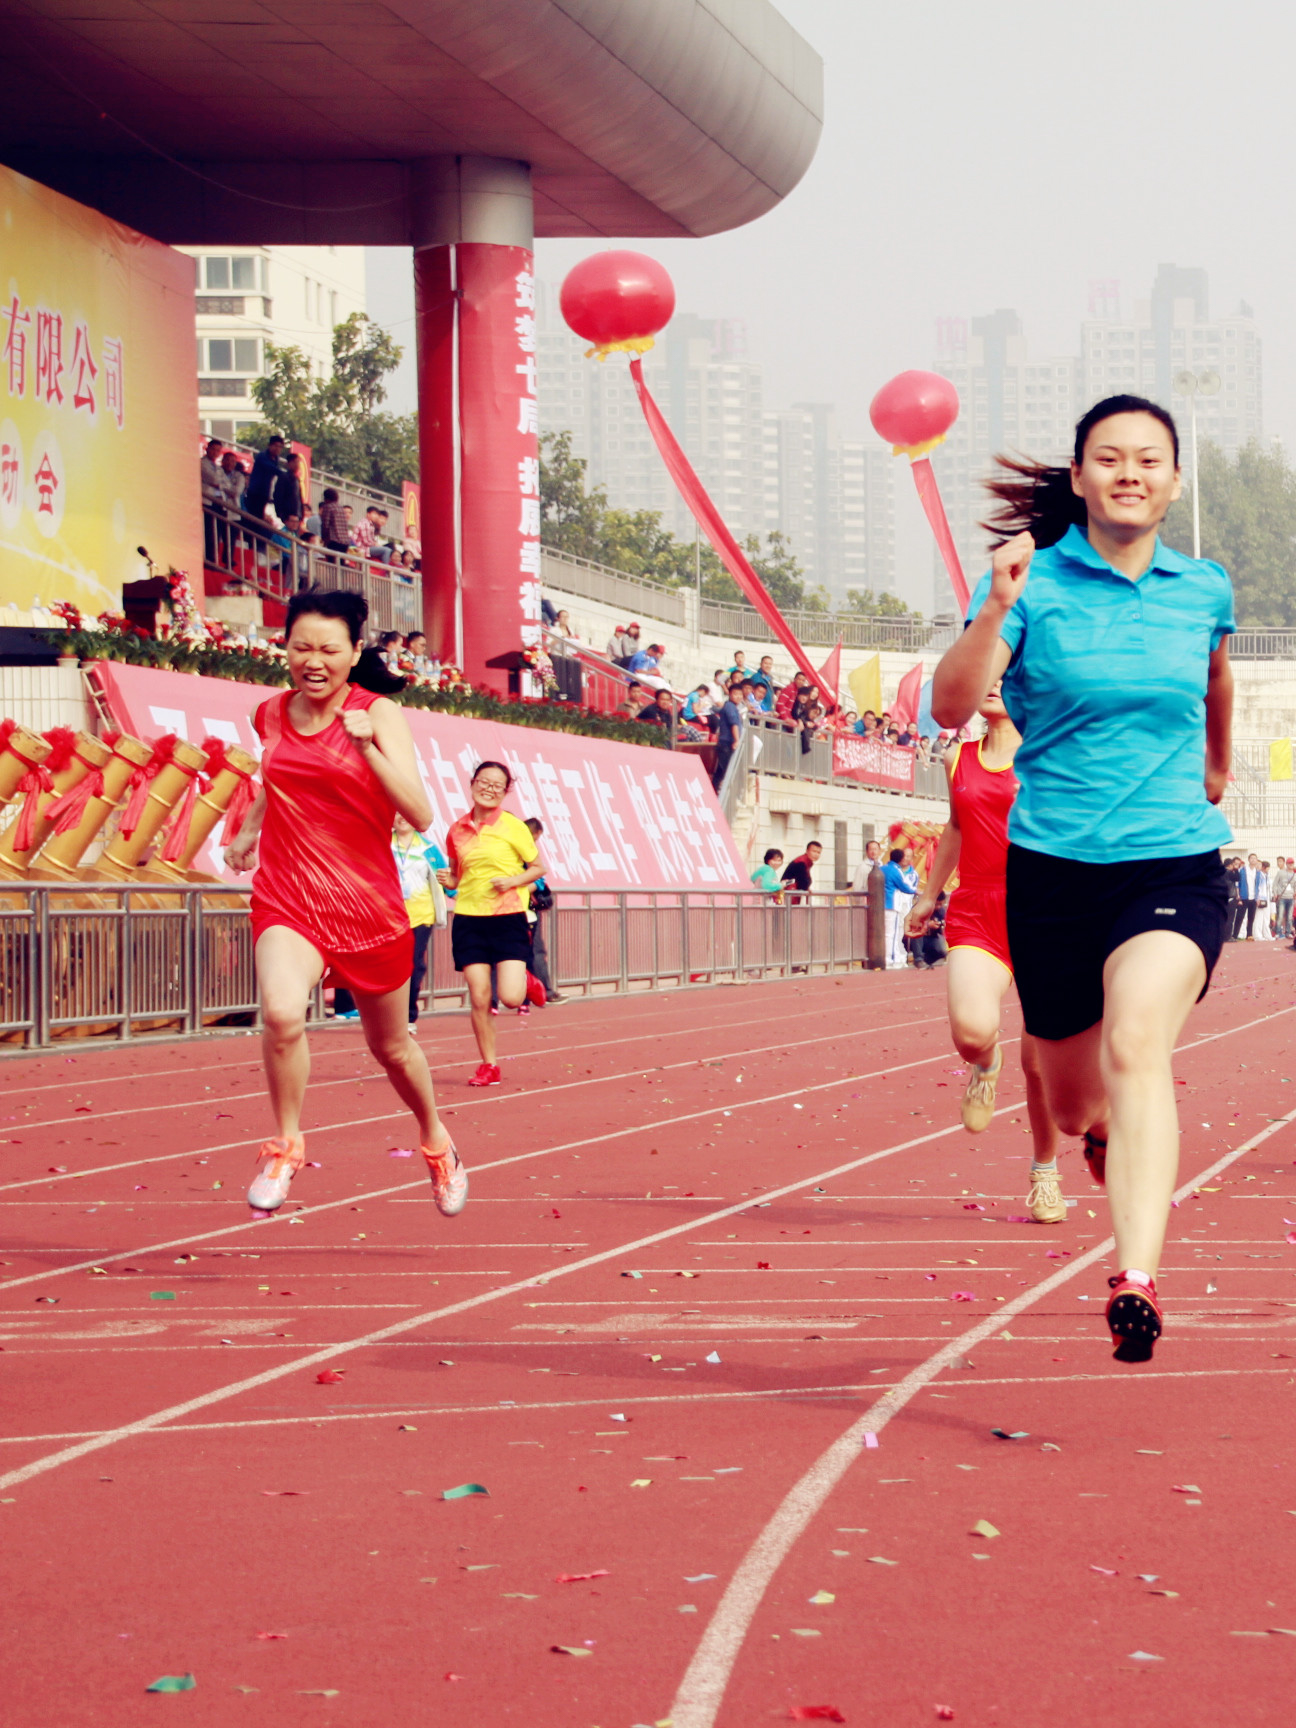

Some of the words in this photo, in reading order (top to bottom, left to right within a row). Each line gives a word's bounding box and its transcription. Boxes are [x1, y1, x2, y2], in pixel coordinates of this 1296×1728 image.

[2, 296, 124, 427] 有限公司
[2, 443, 59, 516] 动会
[619, 764, 740, 884] 快乐生活
